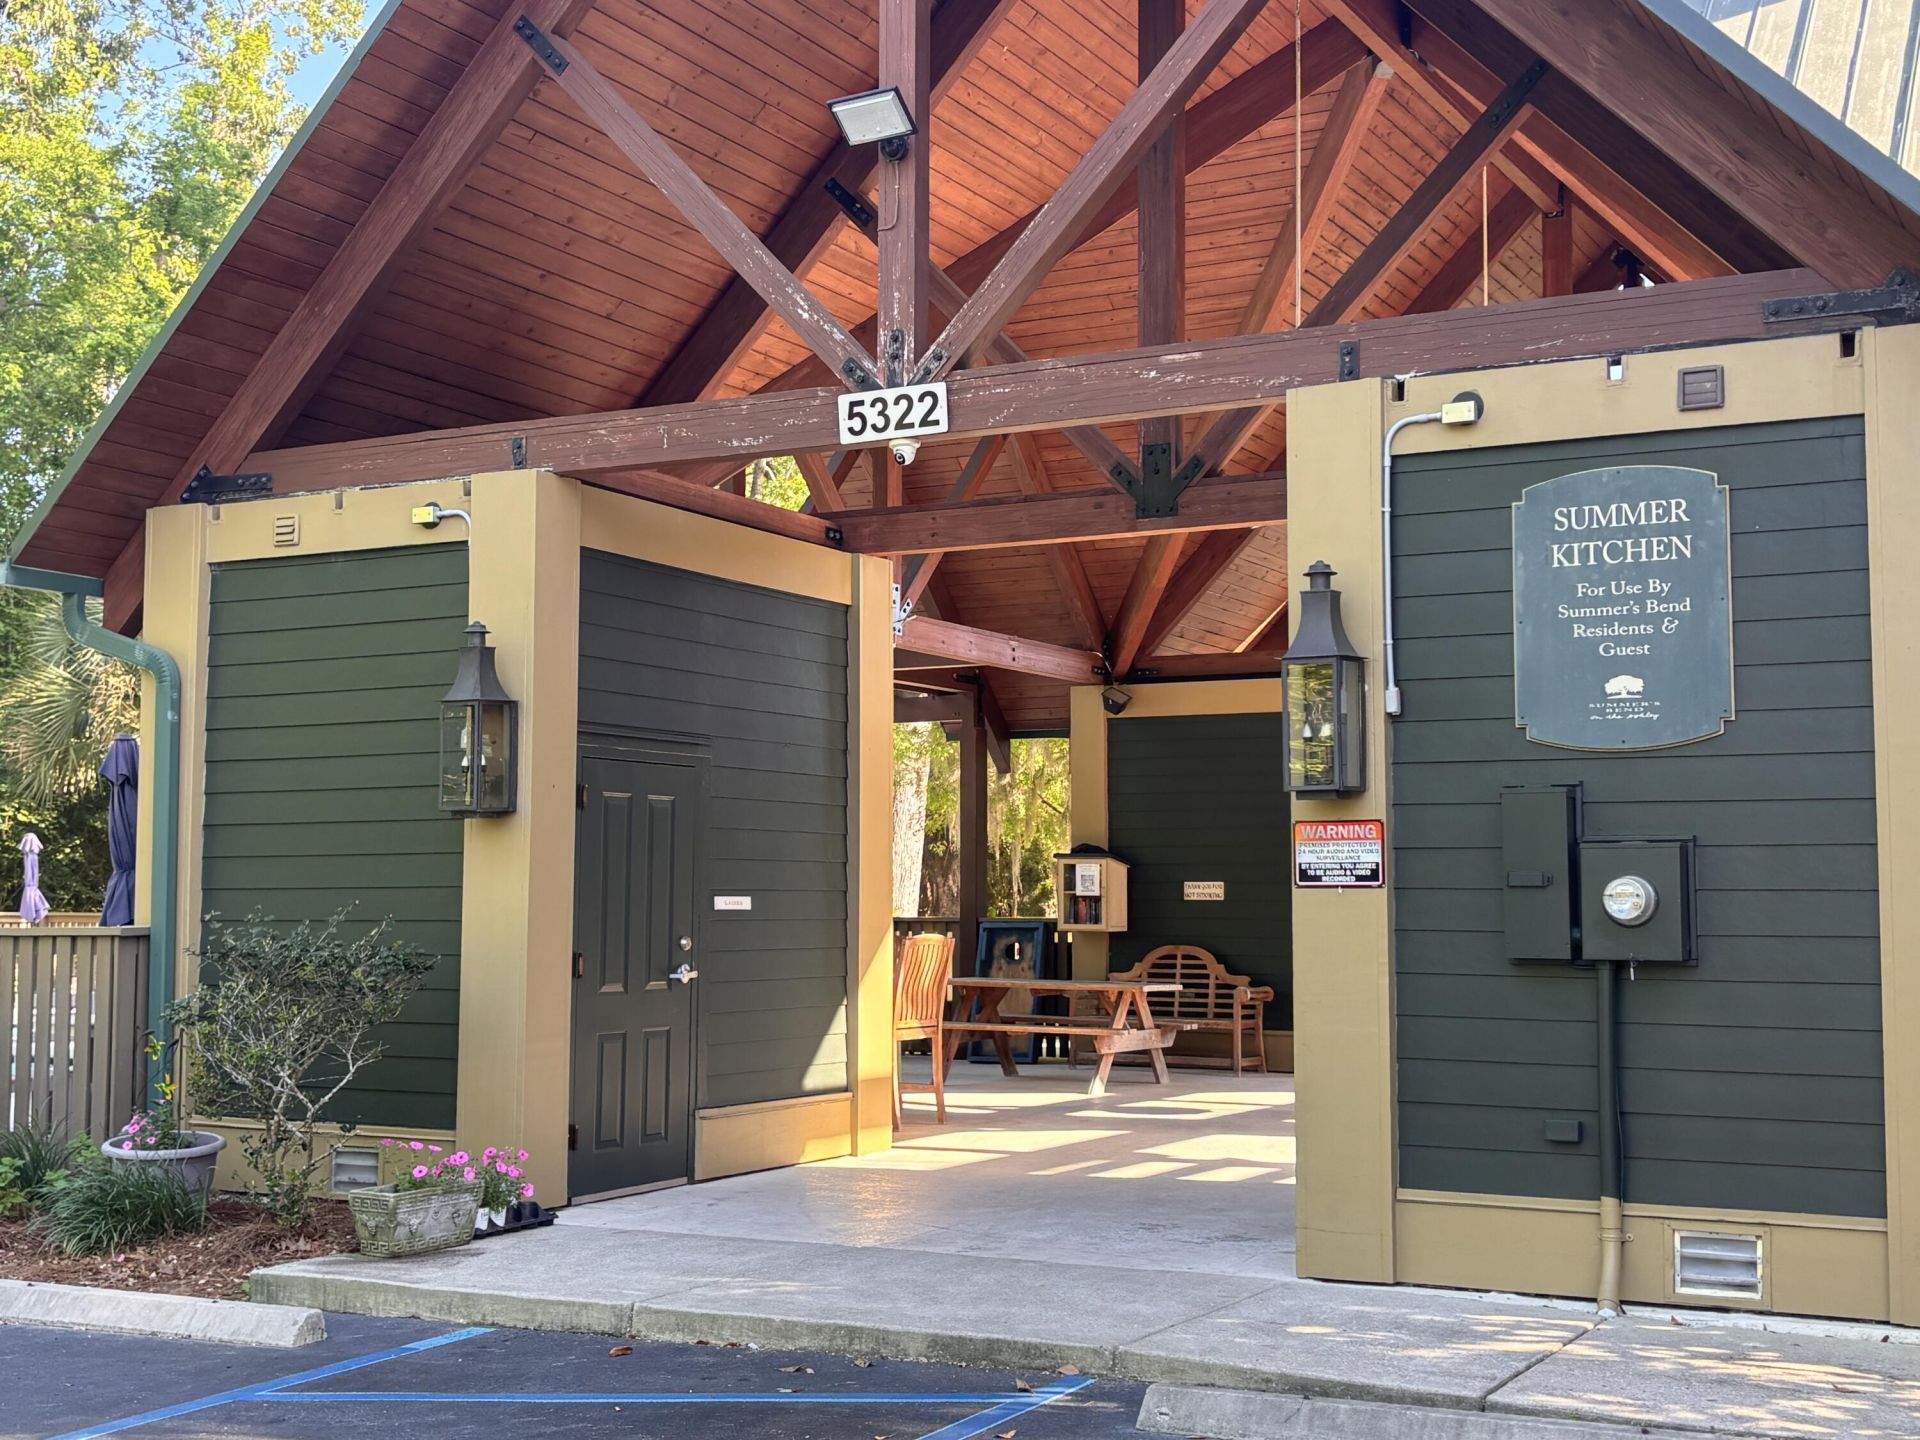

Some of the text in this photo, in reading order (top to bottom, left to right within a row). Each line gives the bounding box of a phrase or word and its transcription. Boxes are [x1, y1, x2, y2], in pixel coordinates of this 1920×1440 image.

[847, 390, 941, 437] 5322
[1553, 498, 1691, 532] SUMMER
[1551, 535, 1693, 568] KITCHEN
[1576, 578, 1672, 598] For Use By
[1557, 597, 1691, 618] Summer's Bend
[1572, 617, 1680, 638] Residents &
[1599, 642, 1651, 657] Guest
[1300, 825, 1377, 839] WARNING
